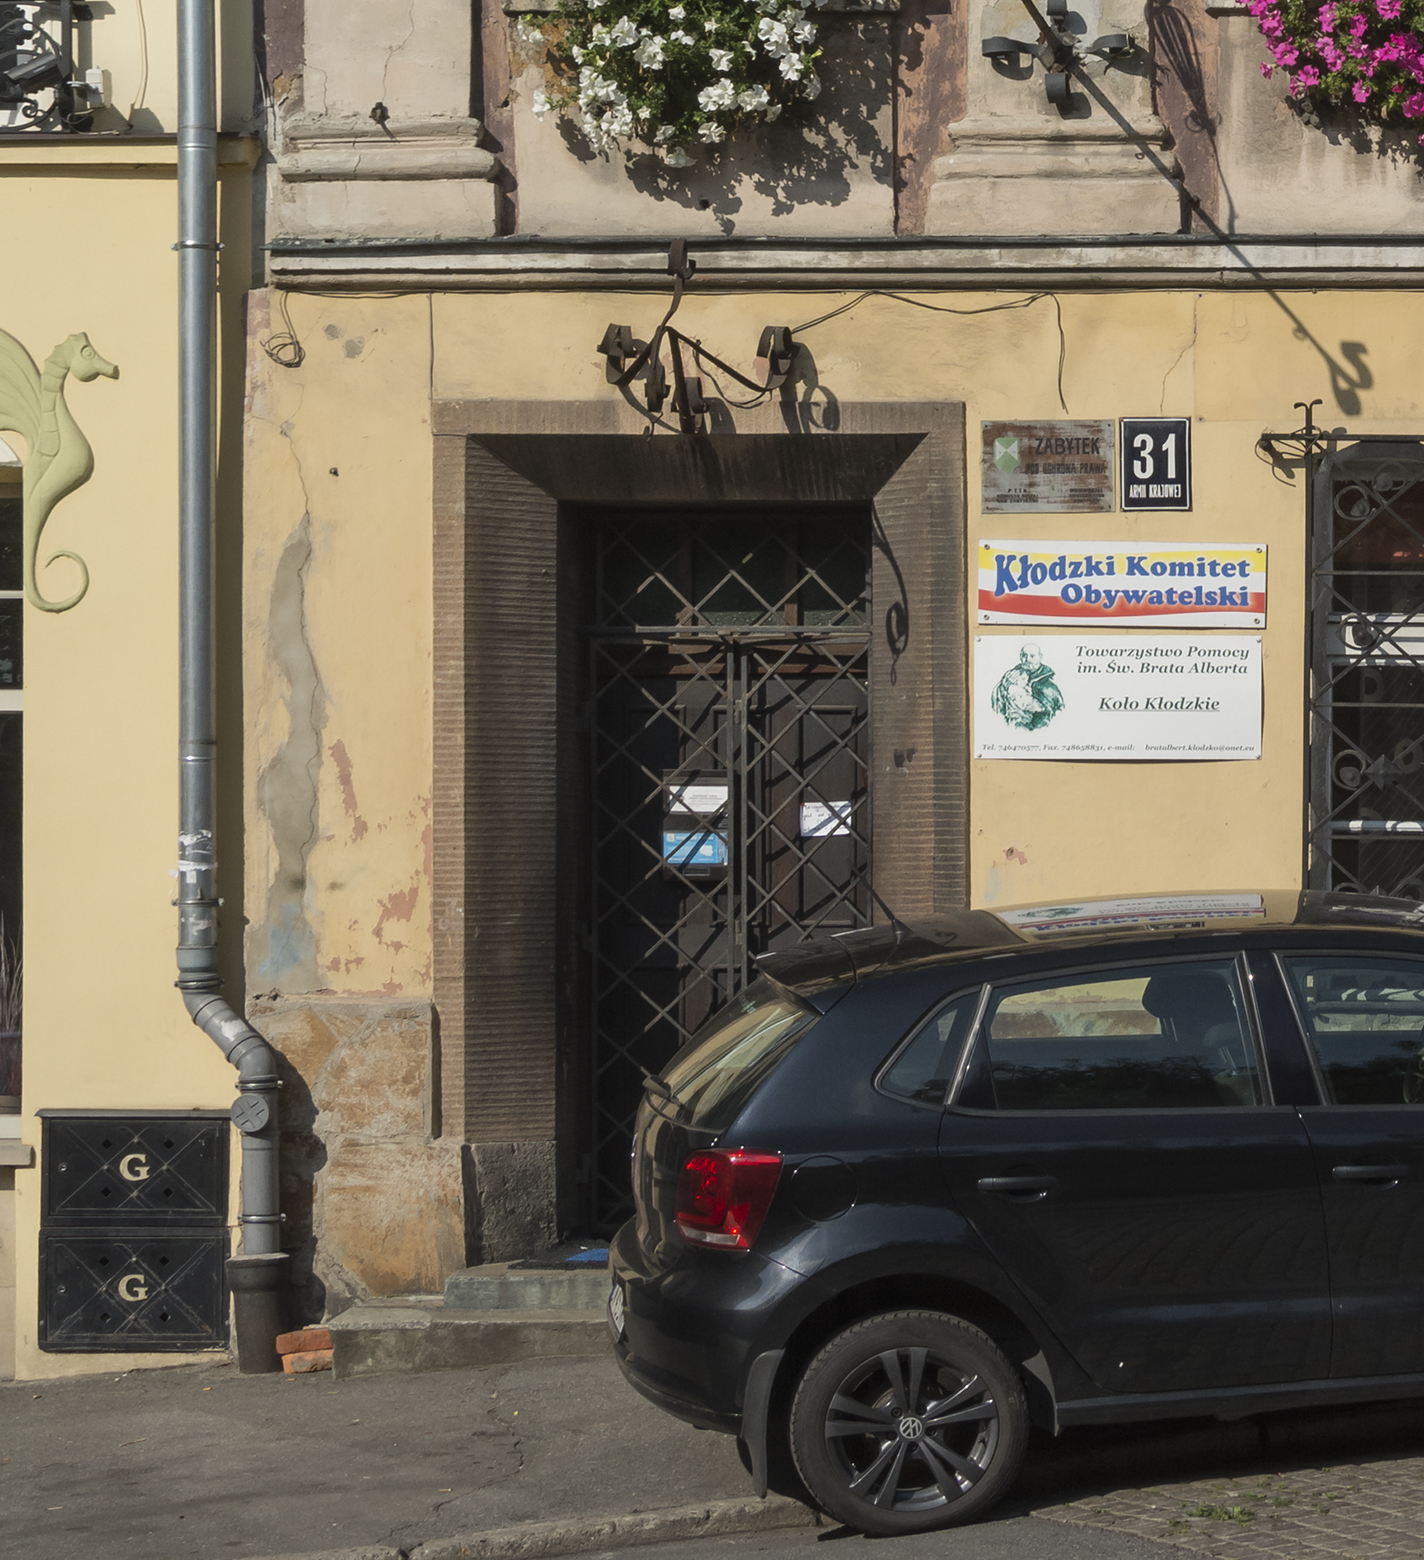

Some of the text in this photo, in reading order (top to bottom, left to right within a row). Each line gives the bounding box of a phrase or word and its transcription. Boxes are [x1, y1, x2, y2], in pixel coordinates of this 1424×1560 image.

[1034, 437, 1100, 455] ZABYTEK
[1133, 433, 1176, 479] 31
[1129, 484, 1181, 498] ARMII KRAJOWEJ
[994, 554, 1250, 597] Kłodzki Komitet
[1060, 583, 1249, 609] Obywatelski
[1076, 645, 1250, 660] Towarzystwo Pomocy
[1077, 659, 1248, 674] im. Św. Brata Alberta
[1144, 696, 1220, 711] Kłodzkie
[119, 1154, 150, 1181] G
[118, 1274, 148, 1302] G
